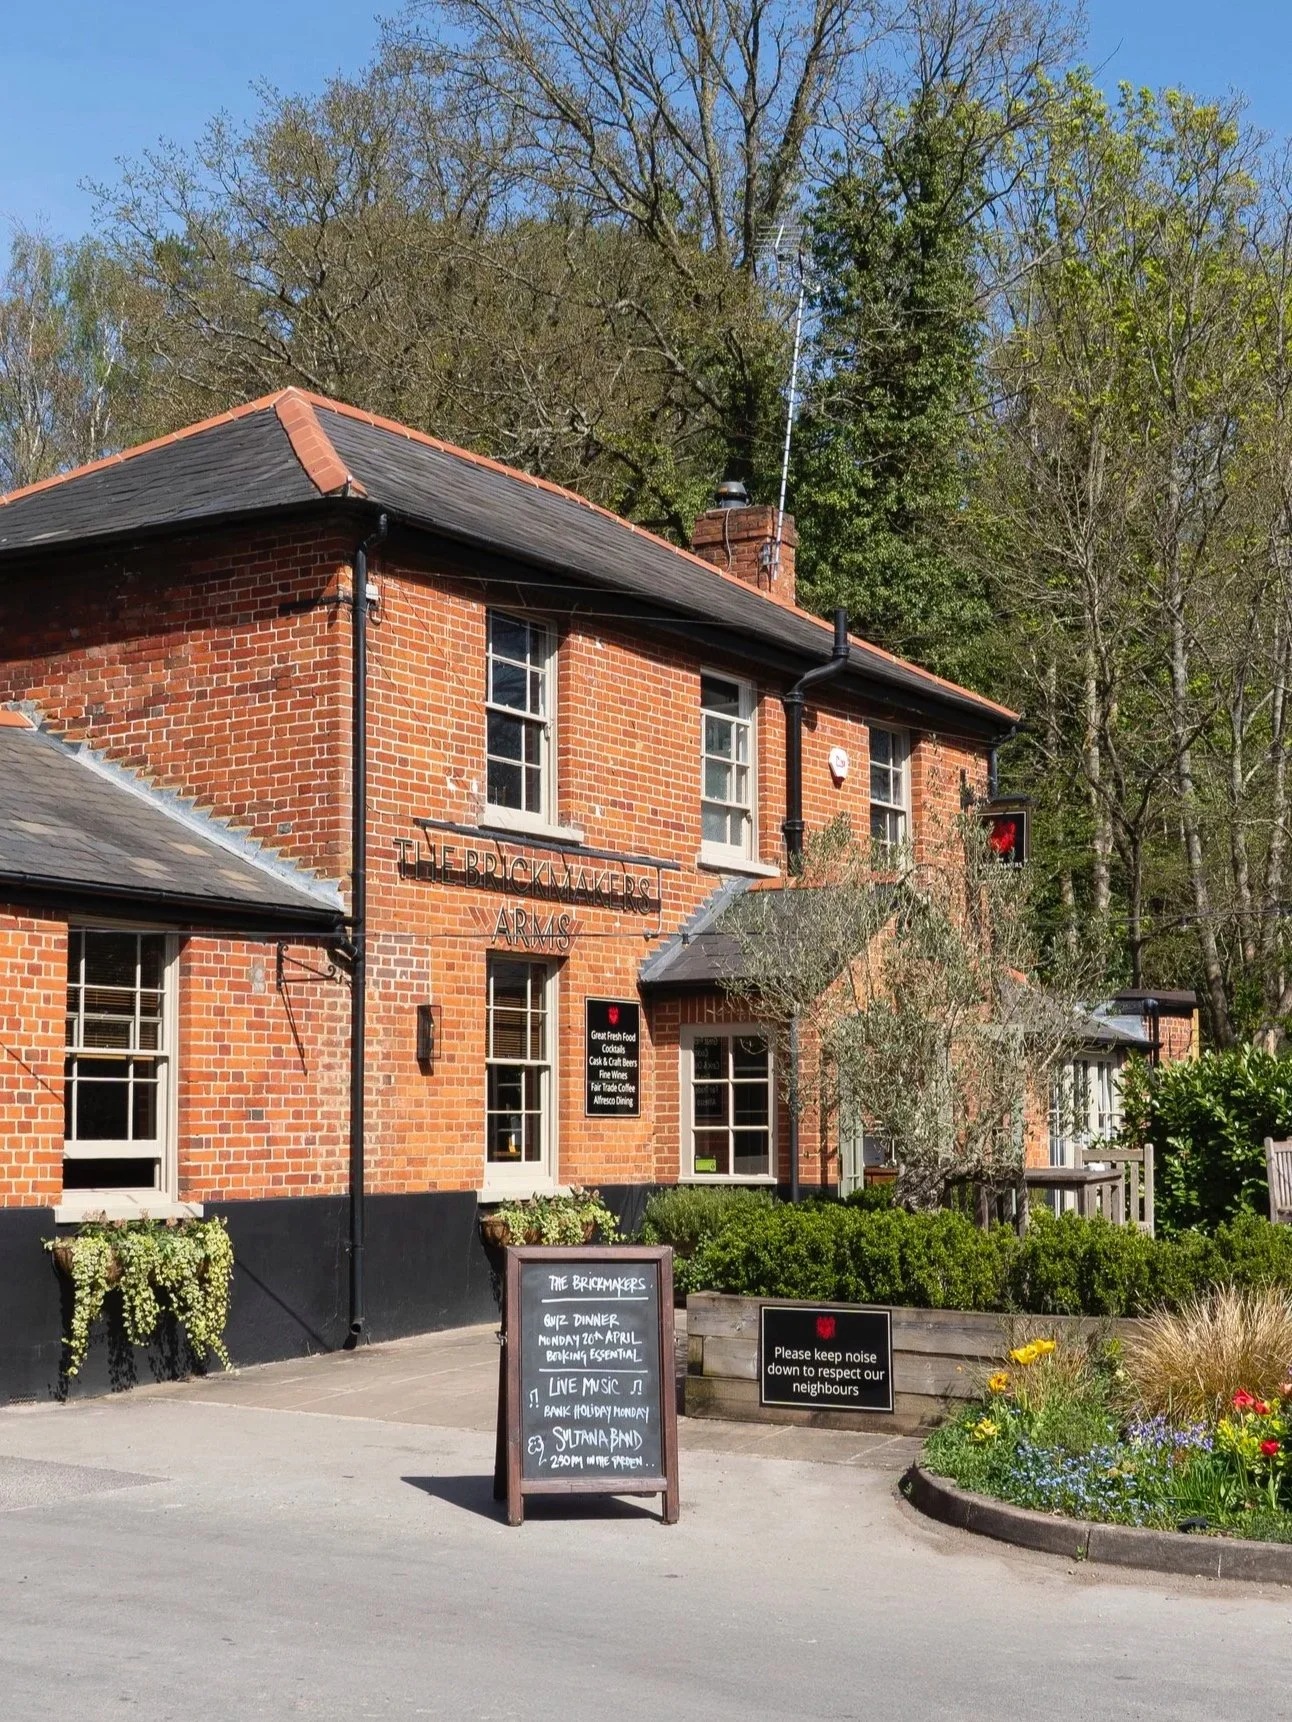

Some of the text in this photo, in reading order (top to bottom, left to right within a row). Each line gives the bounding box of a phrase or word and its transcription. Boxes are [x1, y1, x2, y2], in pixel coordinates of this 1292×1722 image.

[393, 838, 653, 915] THE BRICKMAKERS
[491, 904, 571, 951] ARMS
[591, 1030, 636, 1043] Great Fresh Food
[601, 1043, 626, 1055] Cocktails
[589, 1056, 638, 1069] Cask & Craft Beers
[599, 1069, 628, 1081] Fine Wines
[591, 1082, 636, 1094] Fair Trade Coffee
[593, 1095, 634, 1108] Alfresco Dining
[549, 1274, 646, 1297] THE BRICKMAKERS
[543, 1313, 620, 1330] QUIZ DINNER
[538, 1334, 580, 1348] MONDAY
[605, 1331, 642, 1345] APRIL
[546, 1348, 642, 1367] BOOKING ESSENTIAL
[774, 1346, 877, 1364] Please keep noise
[767, 1362, 885, 1381] down to respect our
[792, 1381, 859, 1397] neighbours
[544, 1404, 571, 1417] BANK
[613, 1405, 649, 1424] MONDAY
[552, 1426, 643, 1453] SULTANA BAND
[586, 1455, 595, 1465] IN
